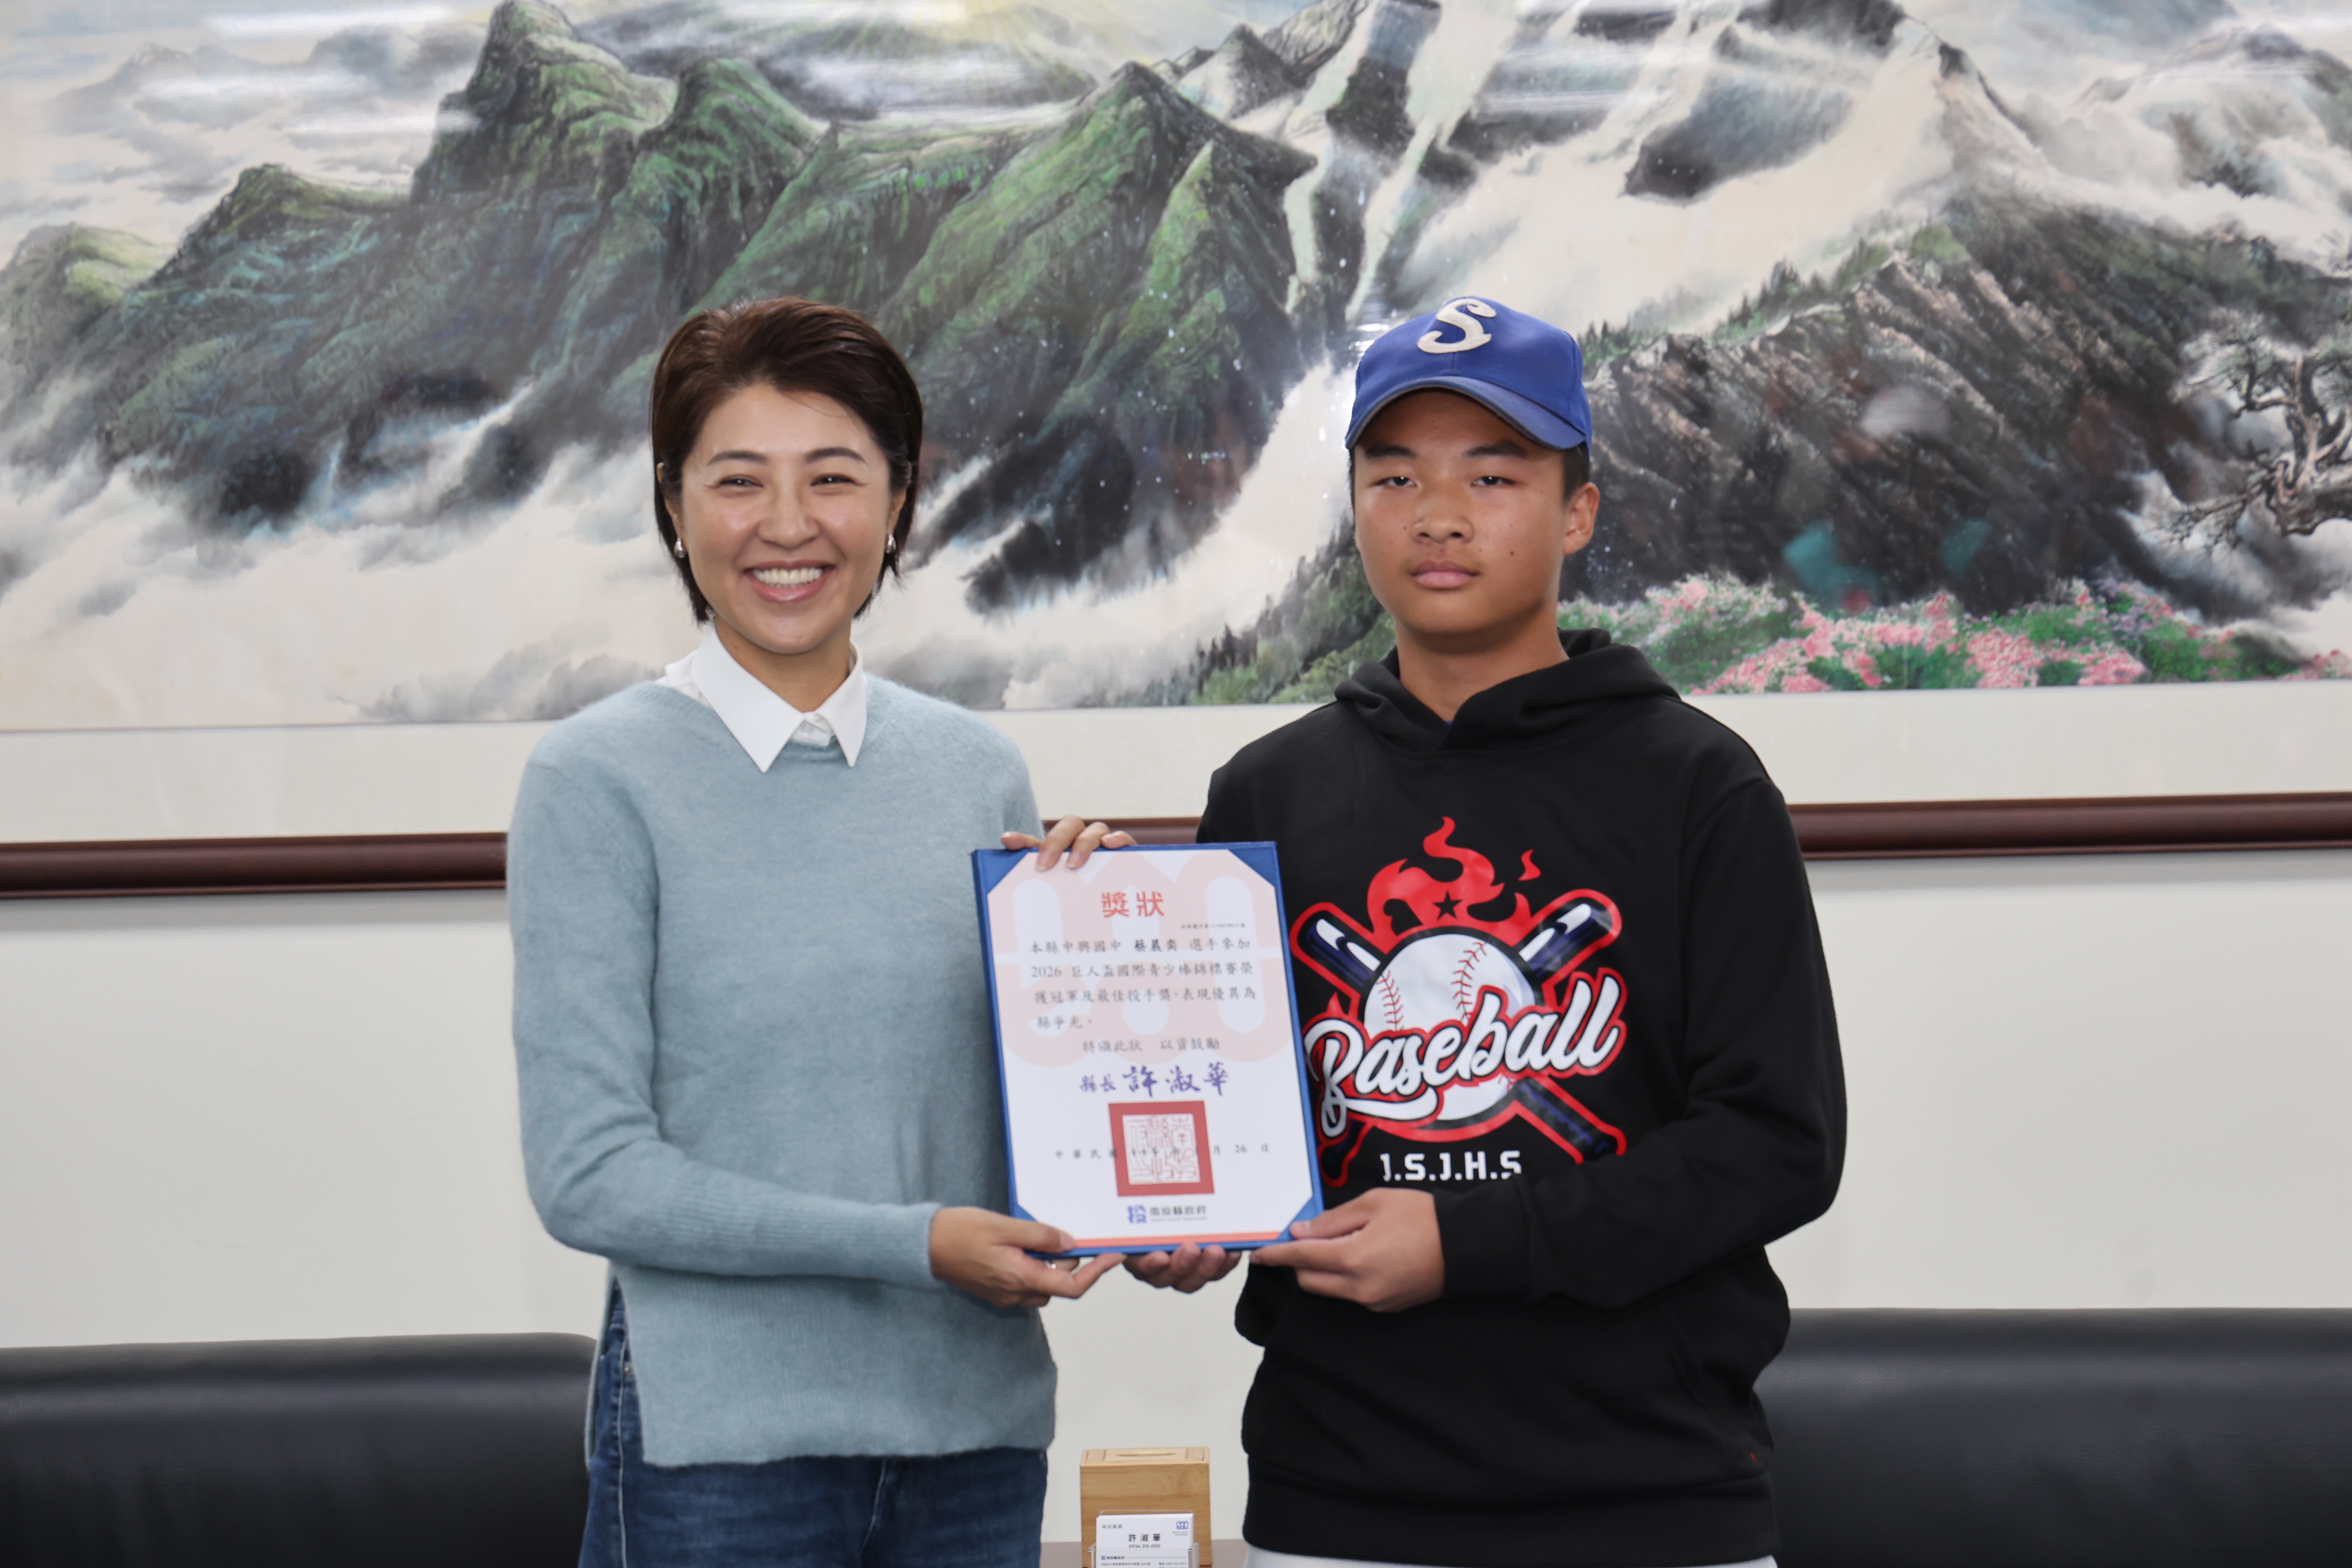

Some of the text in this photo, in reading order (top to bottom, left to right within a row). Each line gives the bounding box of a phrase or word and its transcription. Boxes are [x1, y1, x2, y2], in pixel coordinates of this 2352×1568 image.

[1417, 298, 1497, 354] S
[1102, 891, 1165, 918] 獎狀
[1031, 966, 1062, 978] 2026
[1303, 975, 1621, 1138] Baseball
[1080, 1061, 1228, 1098] 縣長 許淑華
[1129, 1534, 1160, 1542] 許淑華
